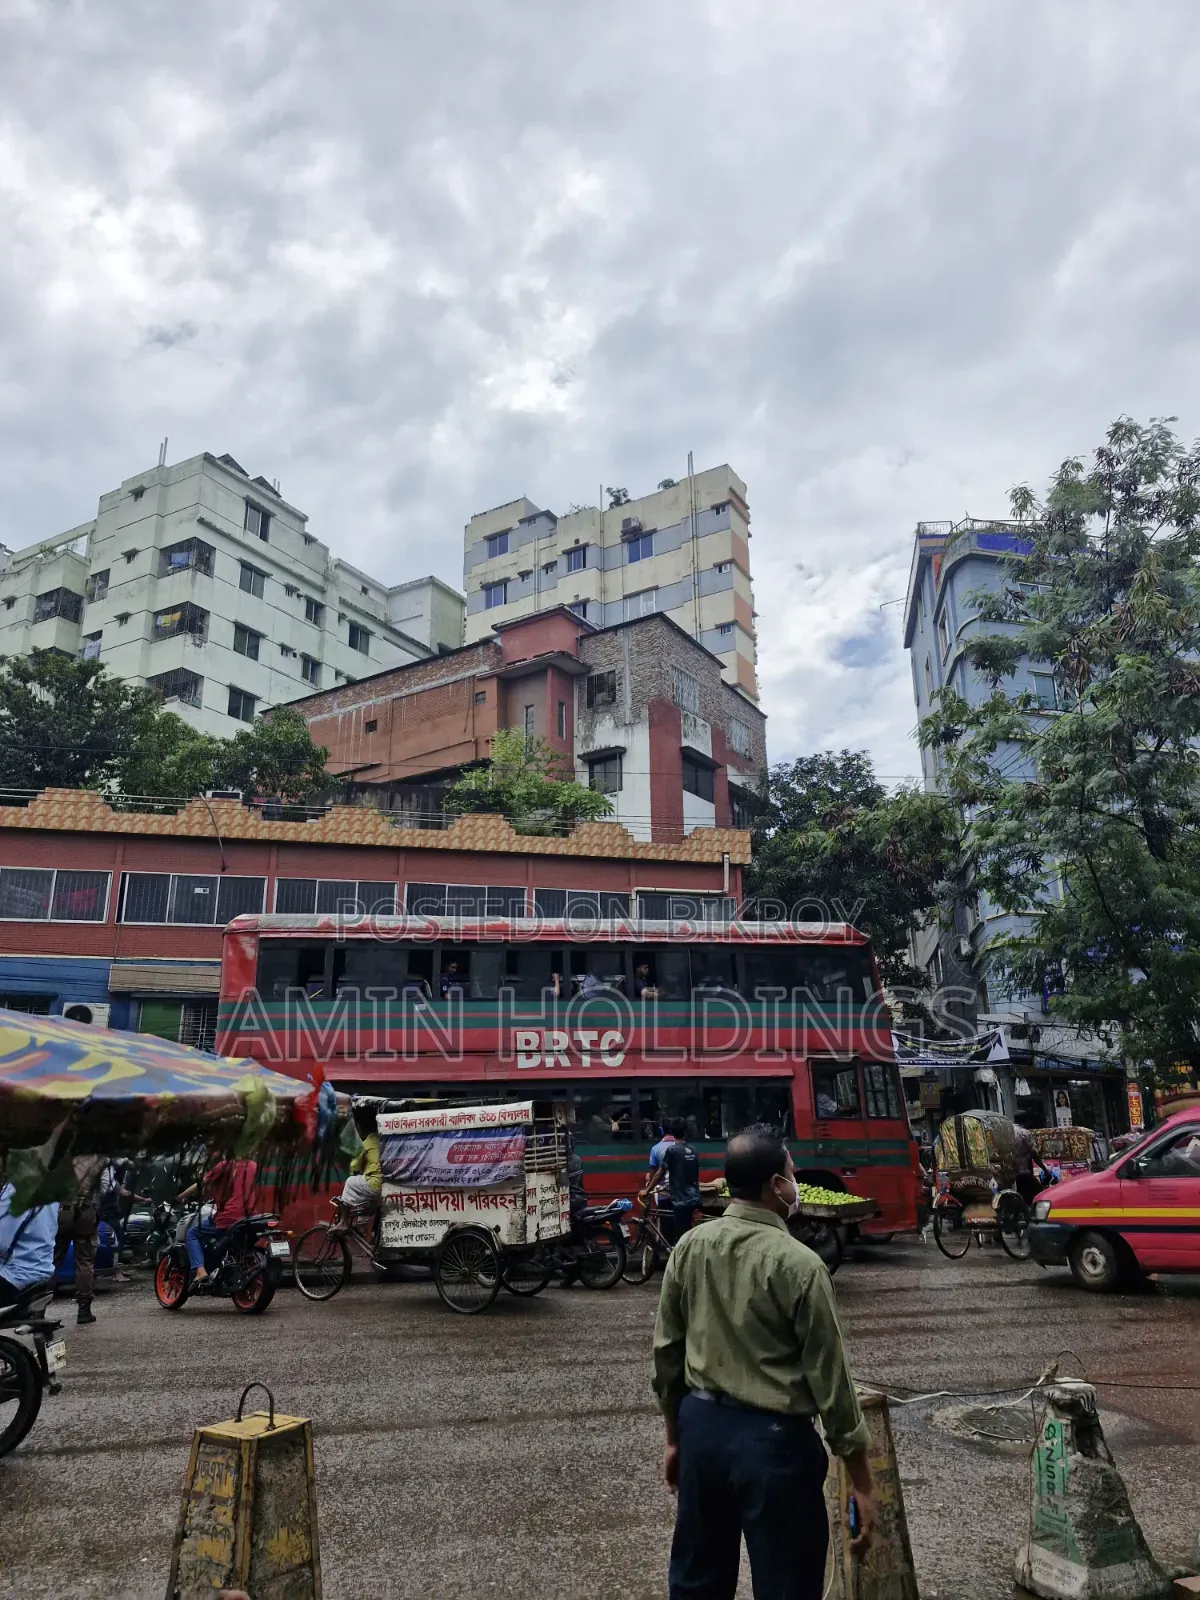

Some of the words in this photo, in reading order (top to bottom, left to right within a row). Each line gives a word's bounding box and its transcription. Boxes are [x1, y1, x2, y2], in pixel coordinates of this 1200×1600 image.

[516, 1030, 625, 1069] BRTC
[417, 1113, 448, 1127] সরকারী
[448, 1112, 476, 1126] বালিকা
[479, 1109, 497, 1123] উচ্চ
[467, 1190, 517, 1211] পরিবহন
